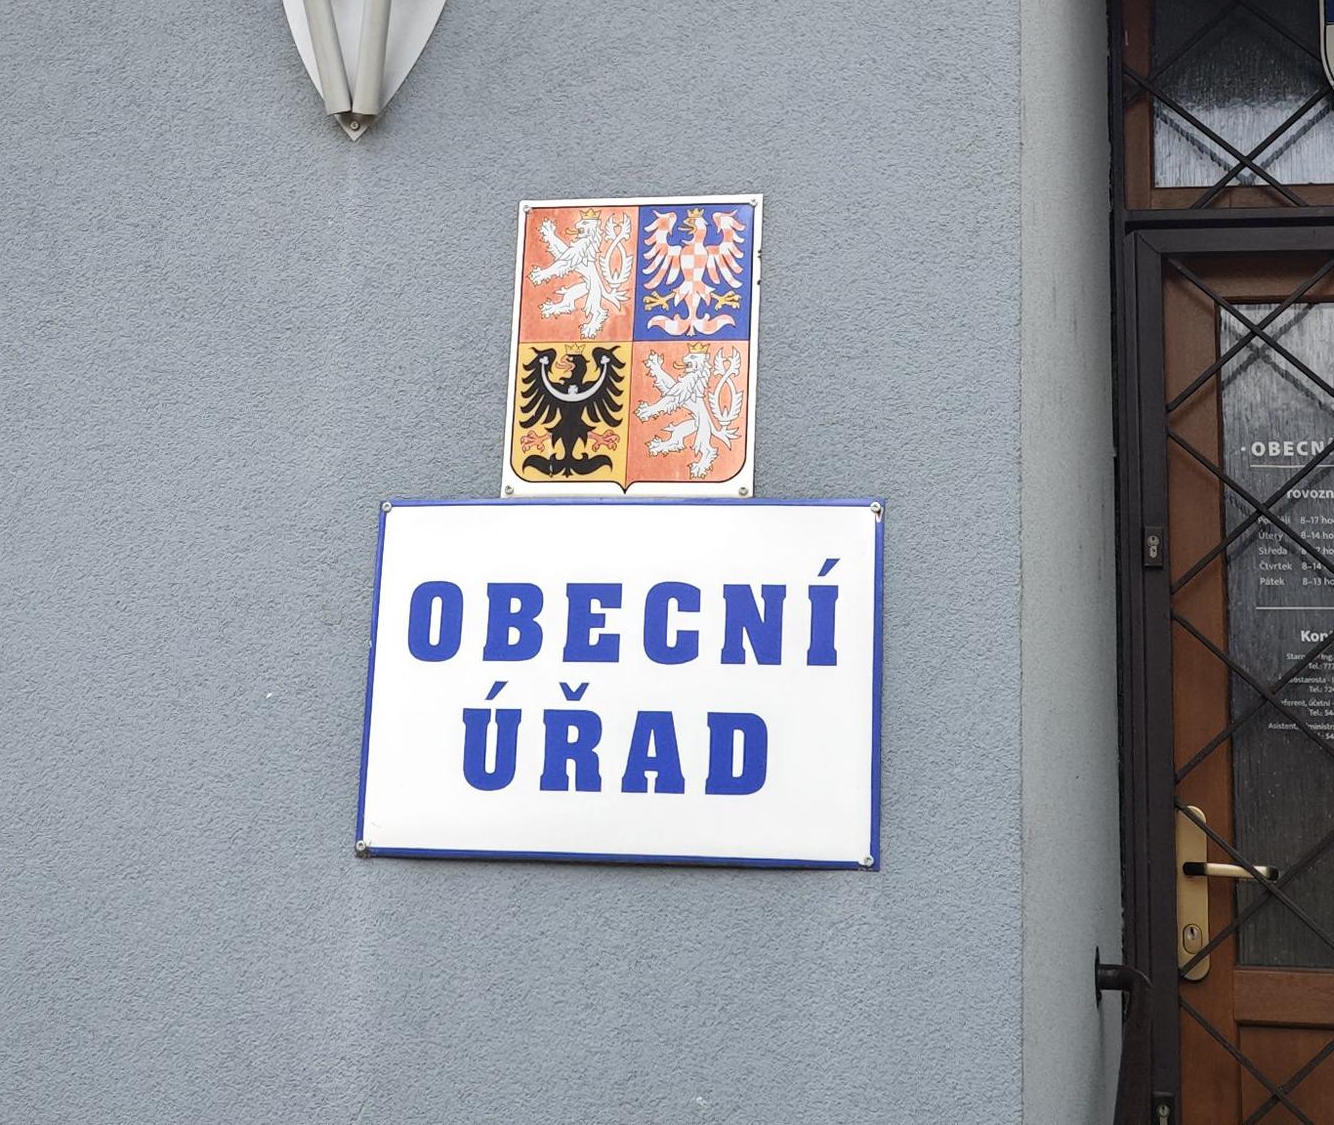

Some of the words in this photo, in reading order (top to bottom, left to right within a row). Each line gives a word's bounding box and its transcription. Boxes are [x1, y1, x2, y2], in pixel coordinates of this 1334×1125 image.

[1259, 560, 1293, 571] Čtvrtek
[1259, 576, 1285, 586] Pátek
[407, 558, 841, 666] OBECNÍ
[1278, 675, 1327, 684] ostarosta
[462, 680, 768, 795] ÚŘAD
